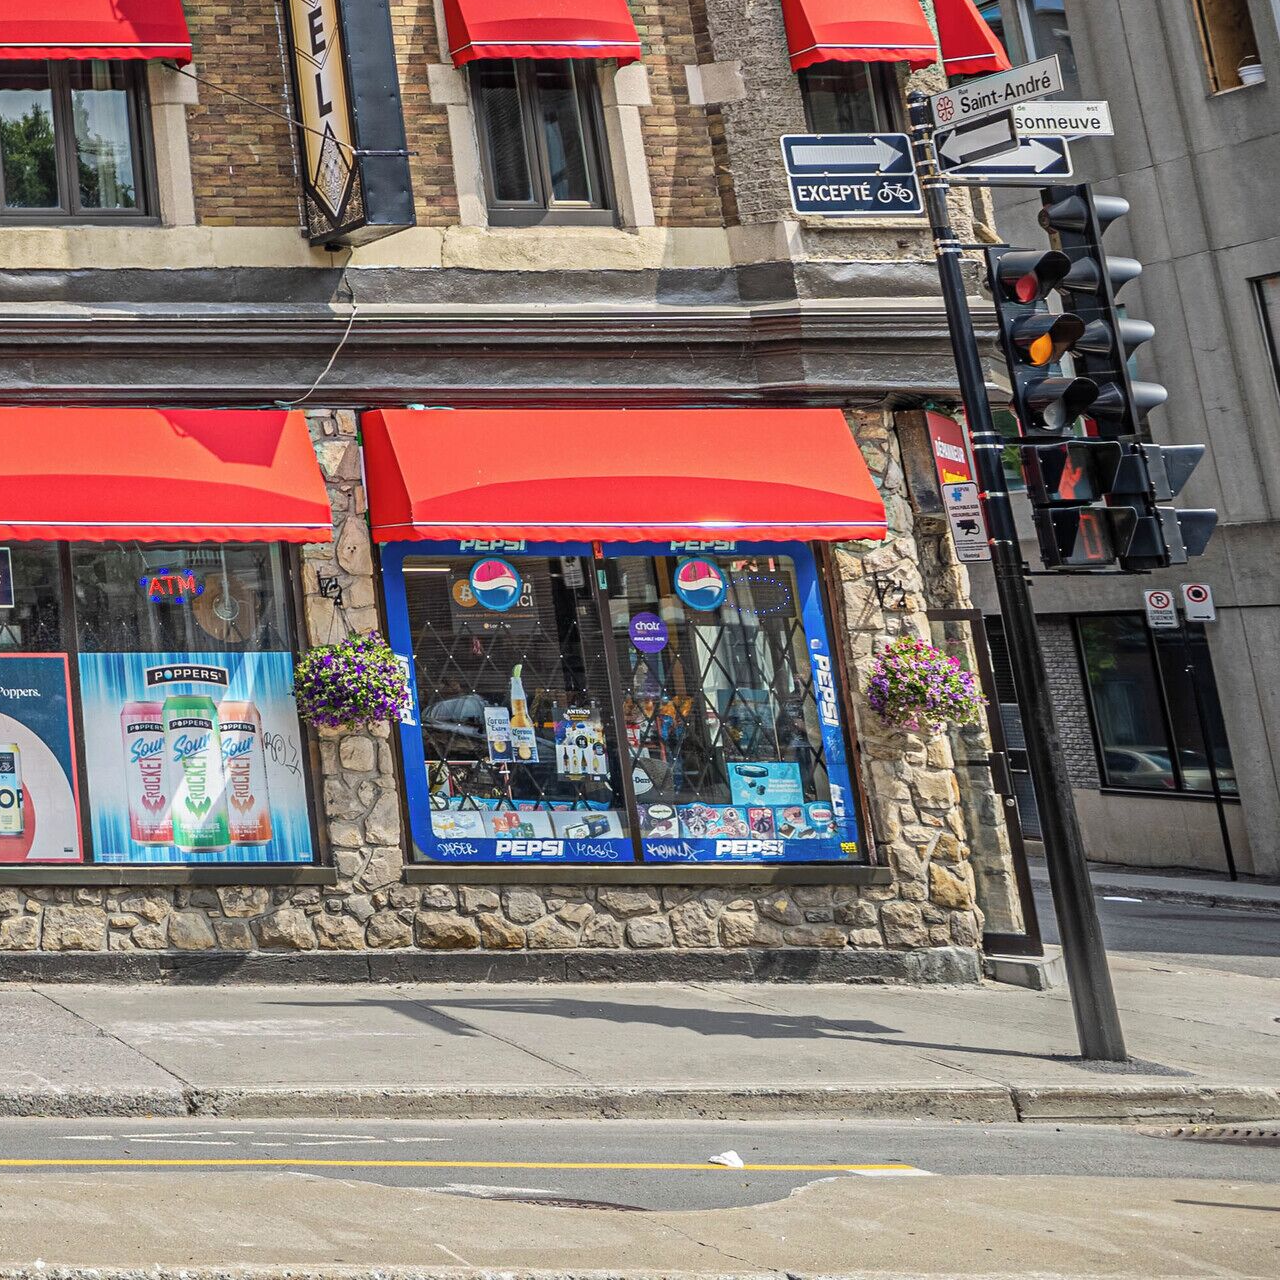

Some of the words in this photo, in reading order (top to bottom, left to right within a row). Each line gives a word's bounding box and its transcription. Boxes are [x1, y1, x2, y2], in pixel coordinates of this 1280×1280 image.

[958, 88, 969, 96] Rue
[960, 72, 1052, 114] Saint-André
[1015, 116, 1101, 130] sonneuve
[797, 179, 873, 202] EXCEPTÉ
[460, 540, 526, 551] PEPSI
[670, 541, 736, 551] PEPSI
[148, 575, 196, 596] ATM
[635, 621, 660, 630] chatr
[154, 669, 219, 681] POPPERS
[813, 653, 840, 726] PEPSI
[172, 720, 209, 728] POPPERS
[173, 734, 210, 762] Sour
[138, 757, 162, 799] ROCKET
[228, 756, 251, 799] ROCKET
[496, 840, 564, 856] PEPSI
[715, 839, 784, 856] PEPSI
